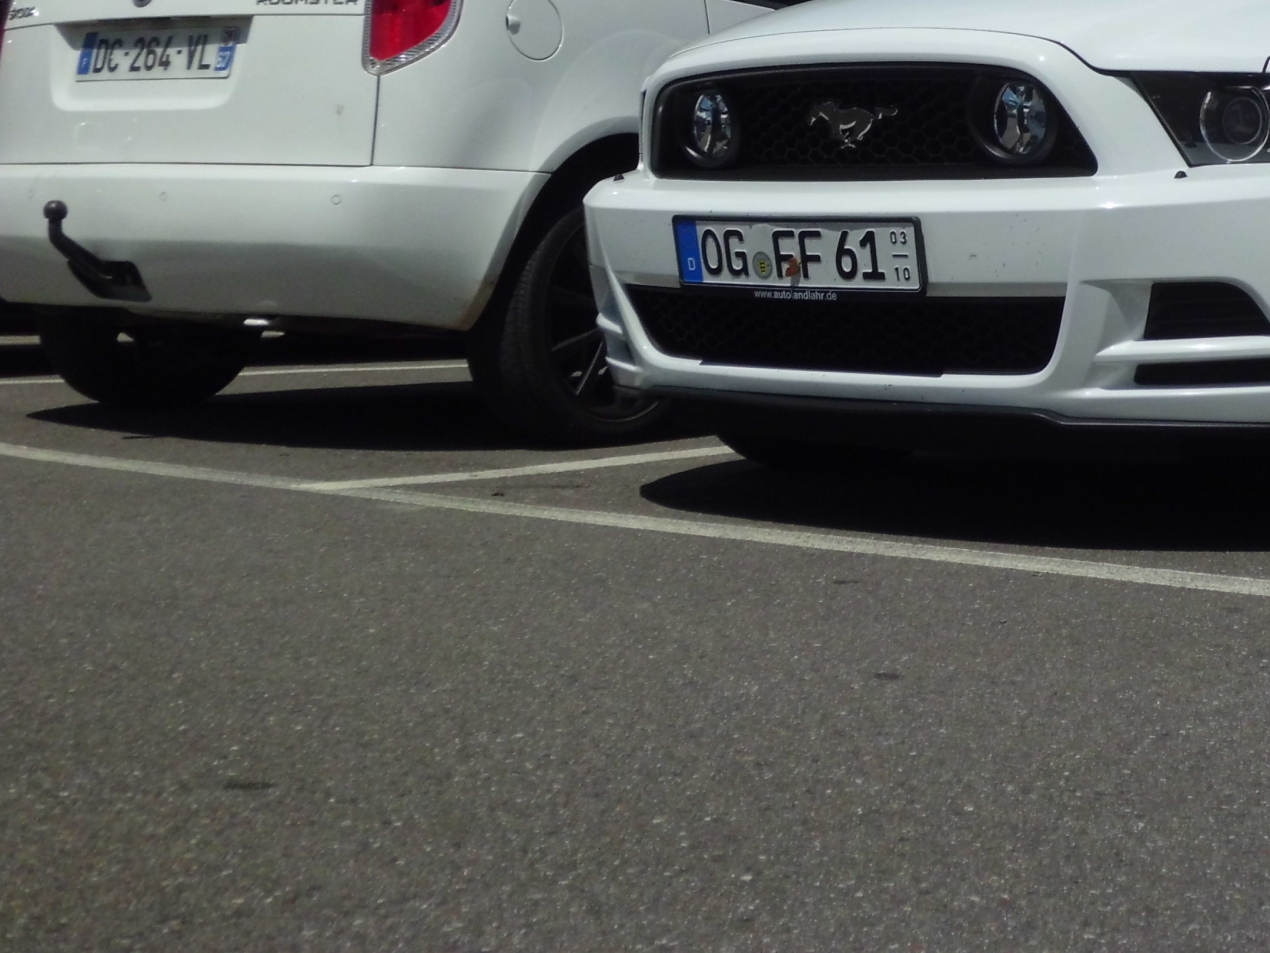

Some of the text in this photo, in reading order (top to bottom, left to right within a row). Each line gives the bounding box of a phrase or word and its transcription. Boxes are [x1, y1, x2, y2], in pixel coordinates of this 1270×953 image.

[687, 228, 907, 281] D OG FF 61 03
[894, 266, 911, 281] 10
